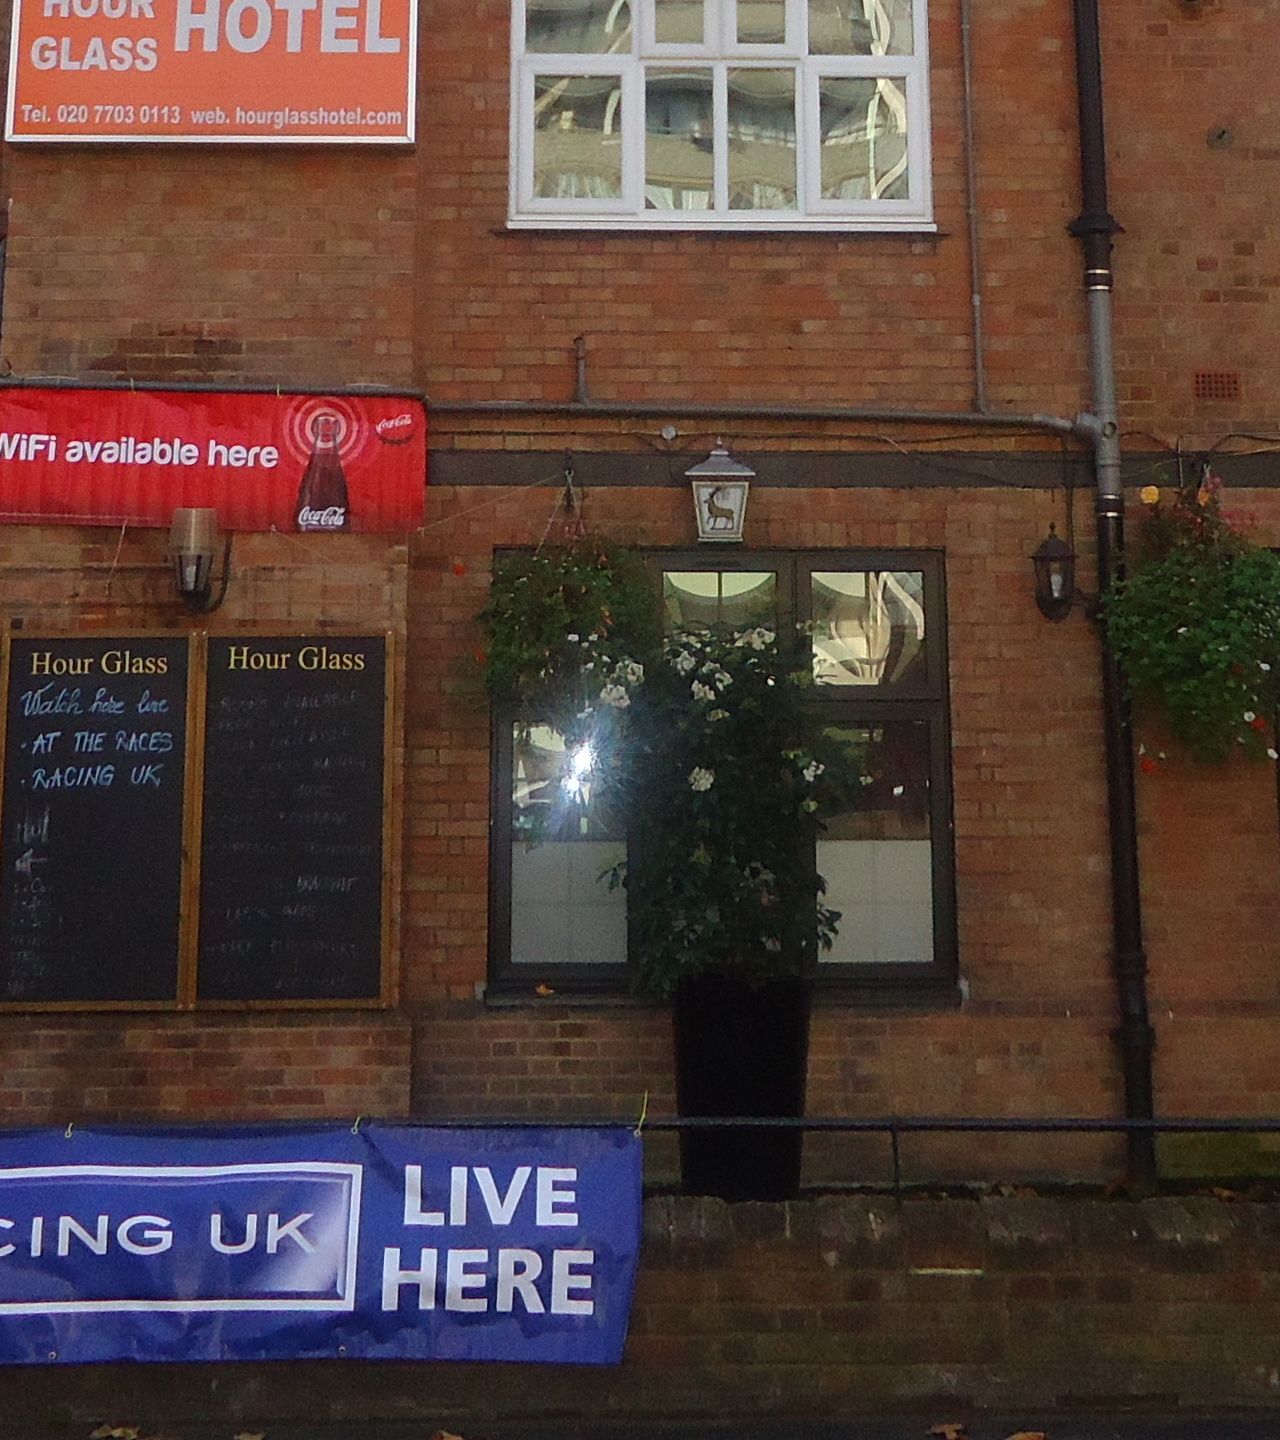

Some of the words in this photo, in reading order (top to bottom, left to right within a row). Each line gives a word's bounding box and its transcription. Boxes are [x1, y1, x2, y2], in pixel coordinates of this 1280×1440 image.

[30, 36, 159, 71] GLASS
[21, 104, 52, 123] Tel.
[57, 106, 88, 124] 020
[93, 106, 135, 124] 7703
[140, 106, 181, 124] 0113
[191, 106, 230, 125] web.
[235, 107, 402, 129] hourglasshotel.com
[65, 437, 198, 466] available
[207, 439, 279, 468] here
[30, 651, 94, 675] Hour
[101, 649, 168, 675] Glass
[228, 646, 291, 671] Hour
[298, 646, 365, 671] Glass
[21, 681, 83, 716] Watch
[32, 732, 61, 754] AT
[74, 731, 104, 751] THE
[116, 730, 173, 752] RACES
[32, 764, 114, 789] RACING
[131, 763, 161, 788] UK
[403, 1165, 580, 1228] LIVE
[211, 1212, 320, 1256] UK
[381, 1248, 595, 1316] HERE
